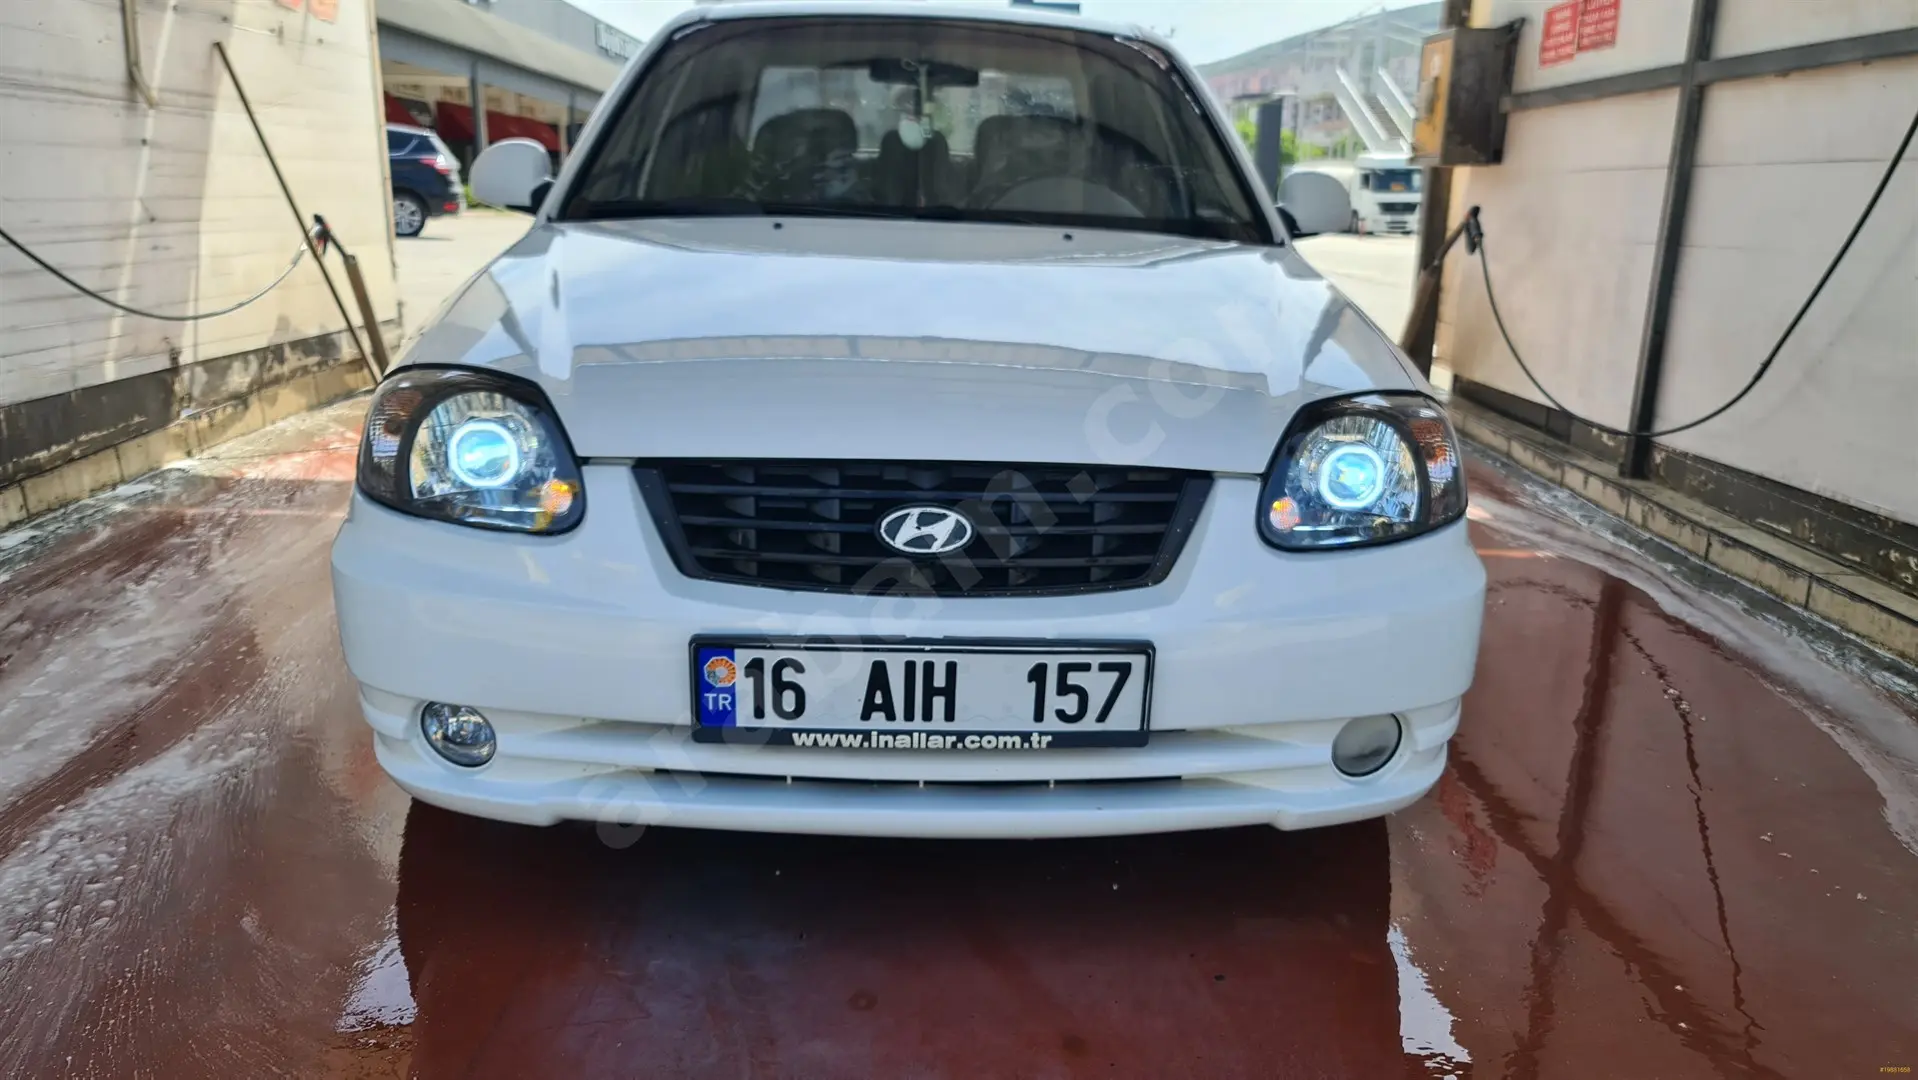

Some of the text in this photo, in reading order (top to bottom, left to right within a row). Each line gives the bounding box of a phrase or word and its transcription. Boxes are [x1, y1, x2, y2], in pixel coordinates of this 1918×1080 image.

[743, 657, 1132, 723] 16 AIH 157
[704, 693, 732, 711] TR
[792, 731, 1052, 749] www.inallar.com.tr
